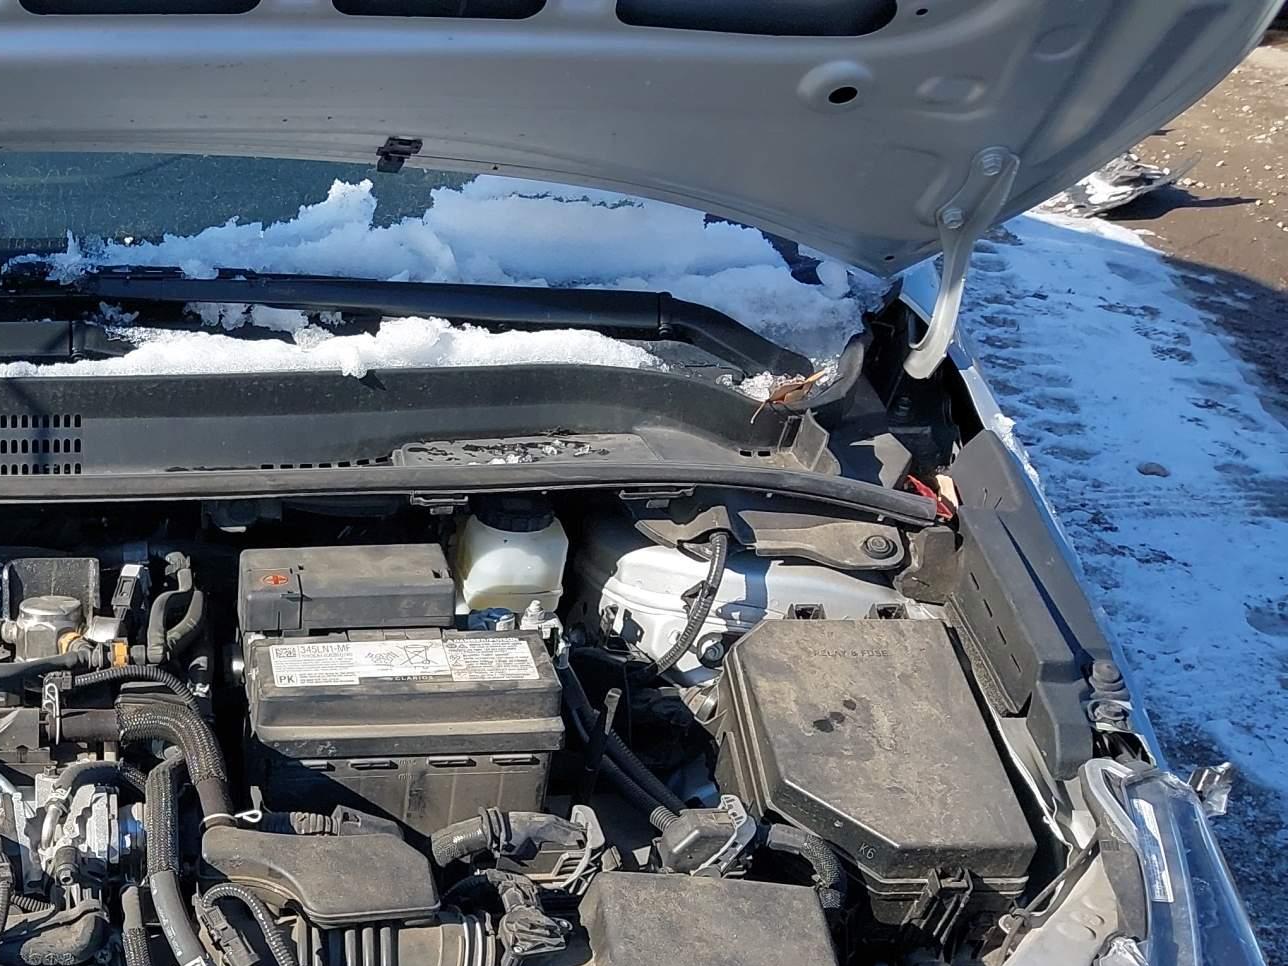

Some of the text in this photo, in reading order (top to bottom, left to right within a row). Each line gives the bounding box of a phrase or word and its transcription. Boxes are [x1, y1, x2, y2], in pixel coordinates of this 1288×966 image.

[300, 644, 351, 655] 345LN1-MF
[279, 675, 295, 683] PK
[859, 842, 877, 859] K6
